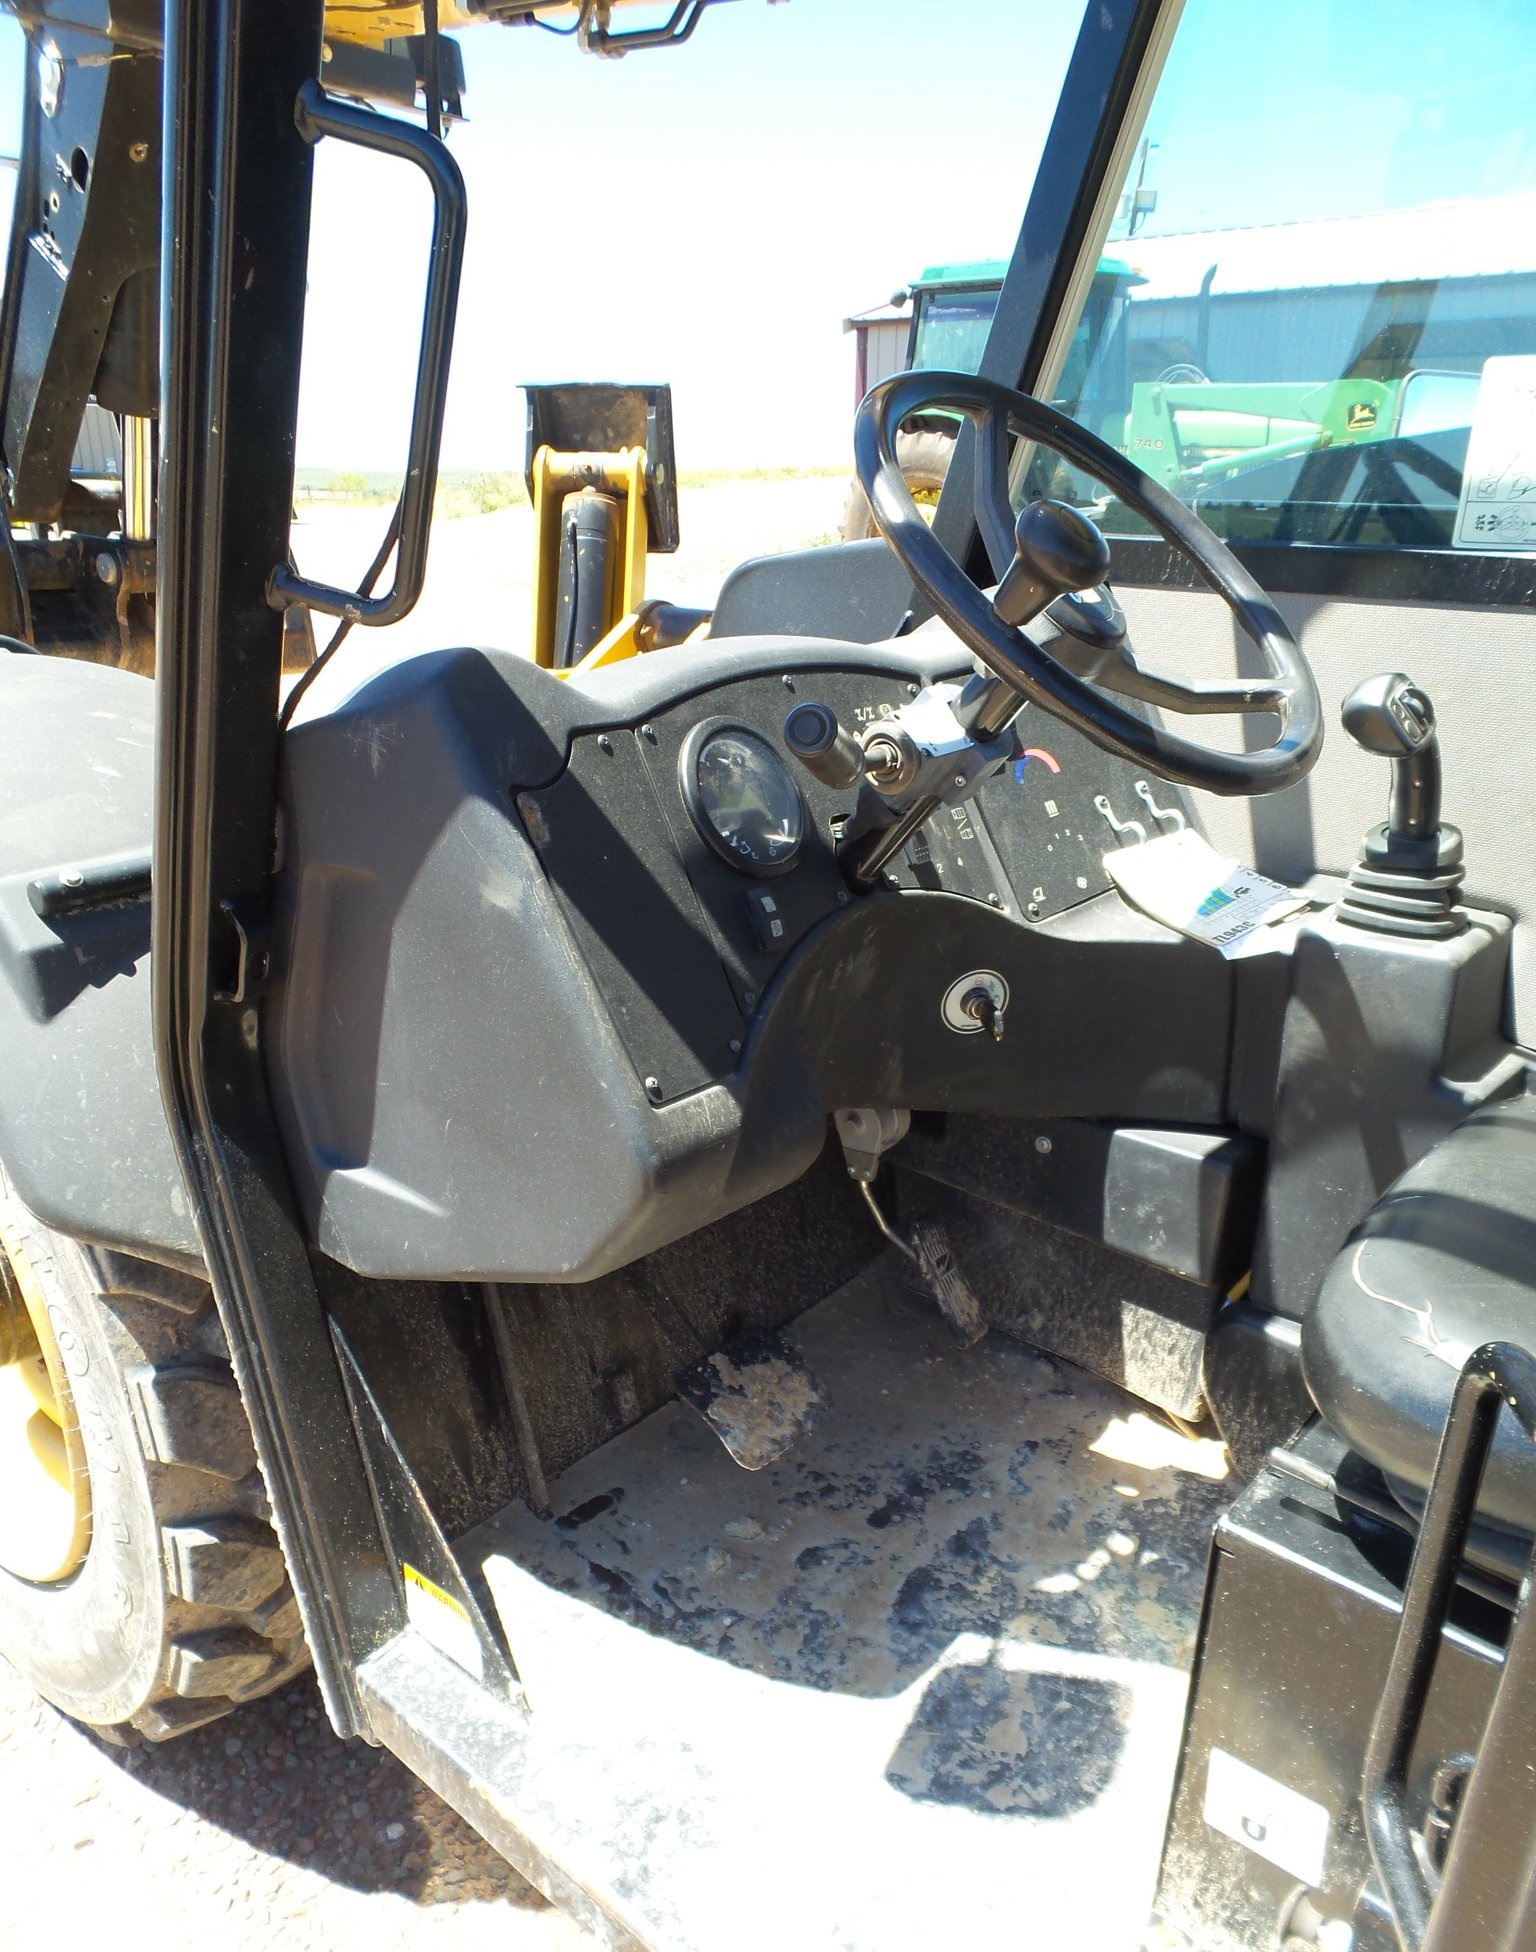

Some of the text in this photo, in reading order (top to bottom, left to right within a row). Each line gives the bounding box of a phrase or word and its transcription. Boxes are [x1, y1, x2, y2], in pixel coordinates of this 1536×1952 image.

[1135, 438, 1164, 449] 740
[936, 863, 944, 874] 2
[1212, 921, 1256, 943] TL943C
